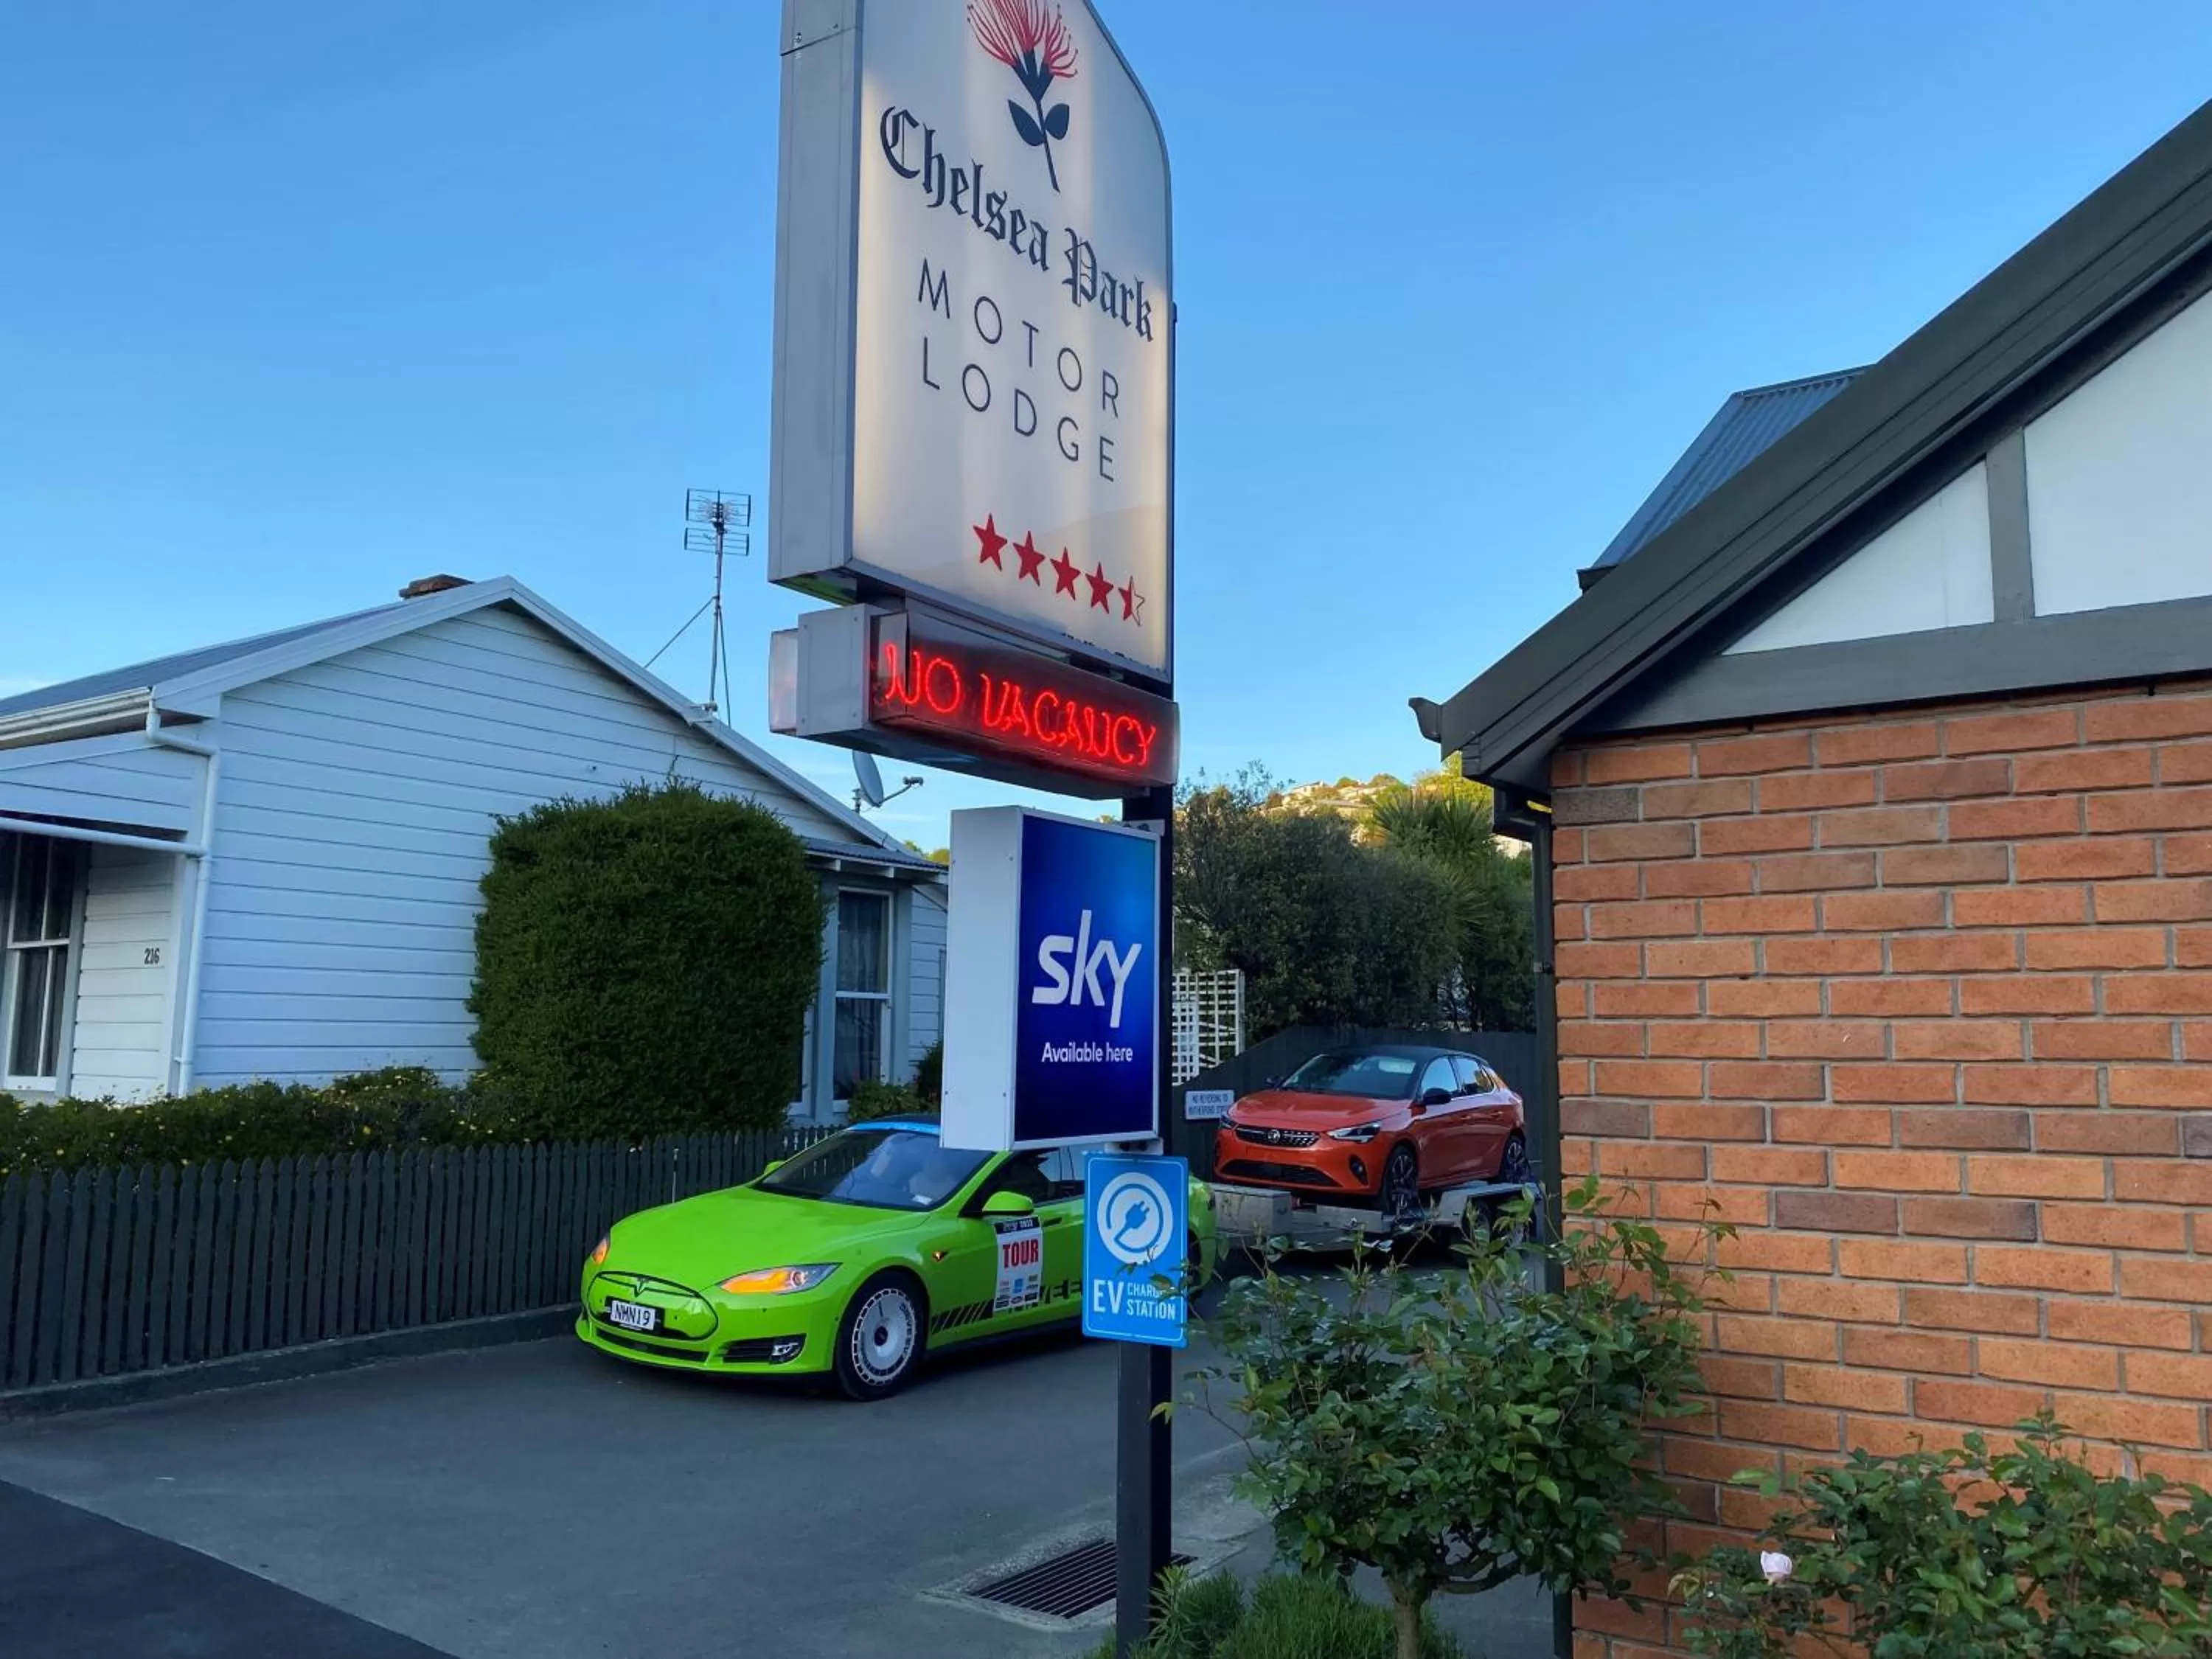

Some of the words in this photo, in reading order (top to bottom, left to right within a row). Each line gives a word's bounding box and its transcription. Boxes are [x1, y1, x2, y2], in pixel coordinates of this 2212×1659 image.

[880, 106, 1050, 272] Chelsea
[1062, 227, 1154, 342] Park
[918, 257, 1119, 418] MOTOR
[922, 336, 1114, 482] LODGE
[885, 642, 960, 714] NO
[980, 672, 1156, 766] VACANCY
[144, 947, 160, 965] 216
[1041, 1041, 1104, 1062] Available
[1106, 1042, 1133, 1062] here
[1002, 1238, 1040, 1270] TOUR
[1093, 1279, 1124, 1315] EV
[1126, 1298, 1176, 1321] STATION
